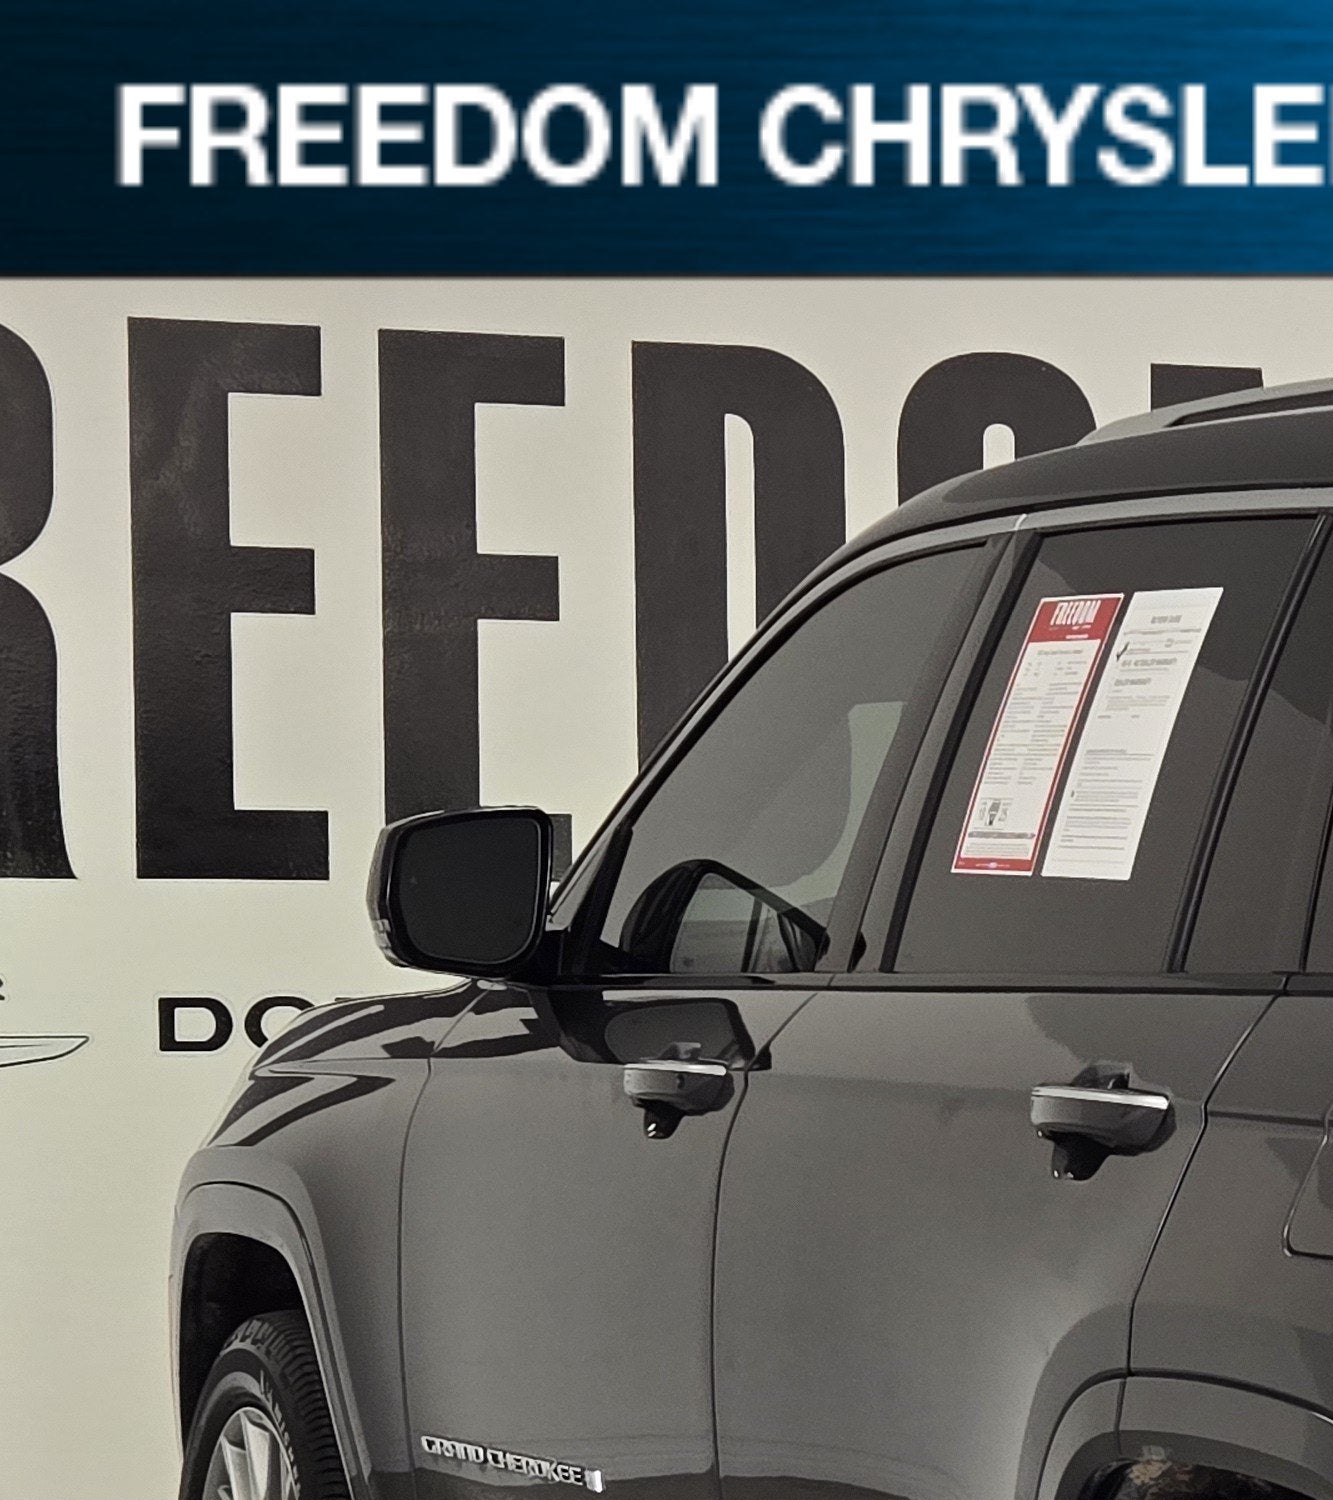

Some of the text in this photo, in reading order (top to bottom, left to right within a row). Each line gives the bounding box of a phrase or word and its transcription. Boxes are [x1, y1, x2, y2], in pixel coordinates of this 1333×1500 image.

[0, 316, 1263, 881] EED
[421, 1435, 484, 1464] GRAND
[486, 1447, 584, 1487] CHEROKEE
